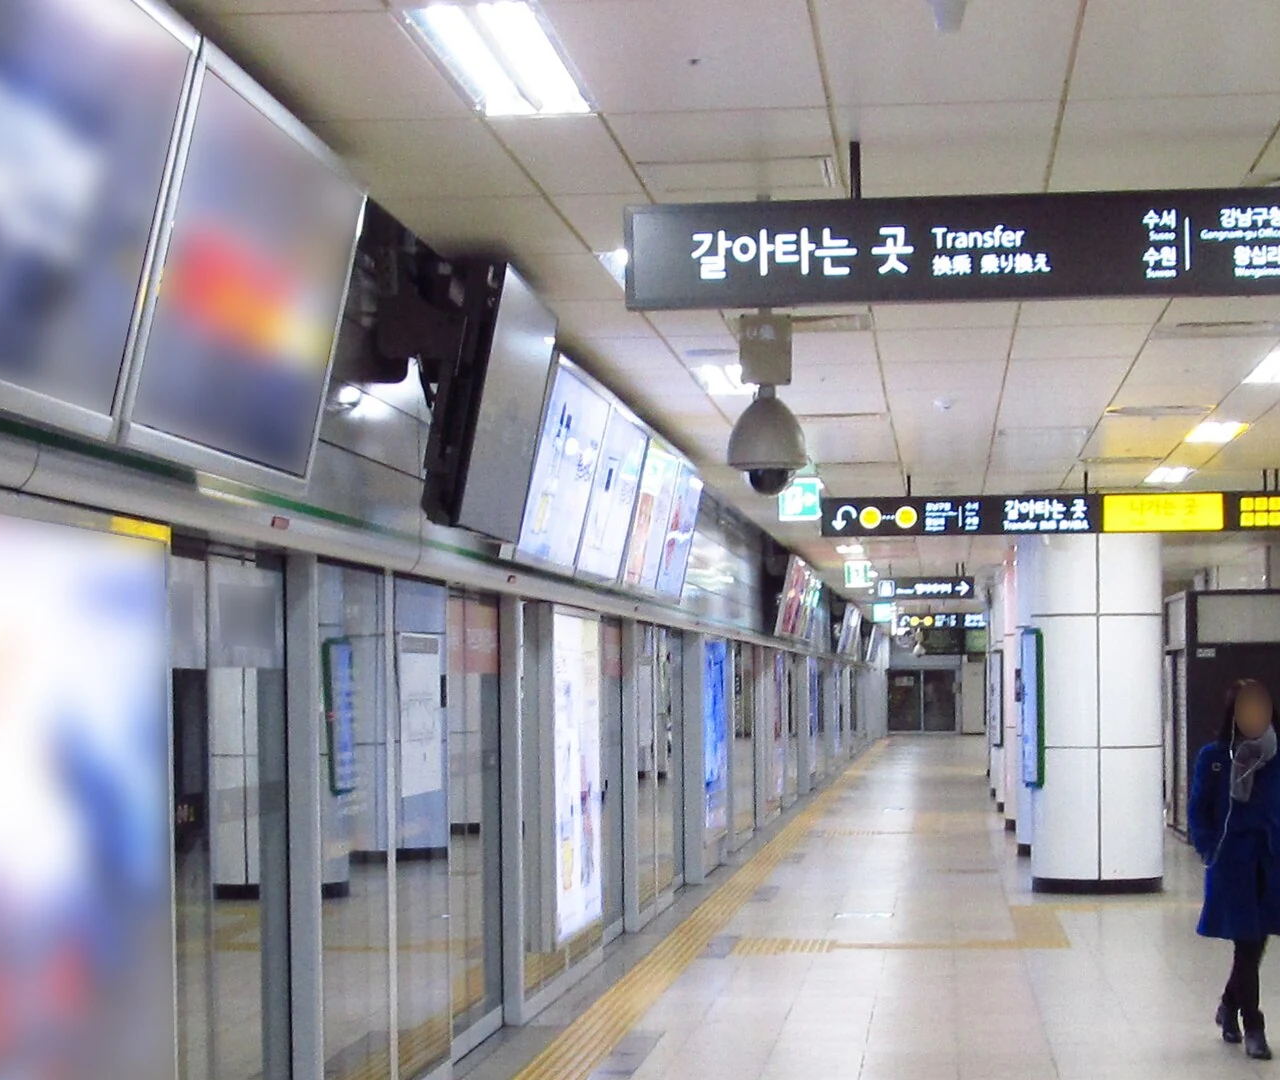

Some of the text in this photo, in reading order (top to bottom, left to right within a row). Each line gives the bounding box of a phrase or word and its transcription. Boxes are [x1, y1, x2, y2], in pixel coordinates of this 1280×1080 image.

[1142, 208, 1177, 230] 수서
[930, 223, 1026, 250] Transfer
[690, 225, 915, 280] 갈아타는 곳
[1142, 245, 1178, 268] 수원
[1003, 498, 1088, 520] 갈아타는 곳
[1129, 499, 1177, 516] 나가는
